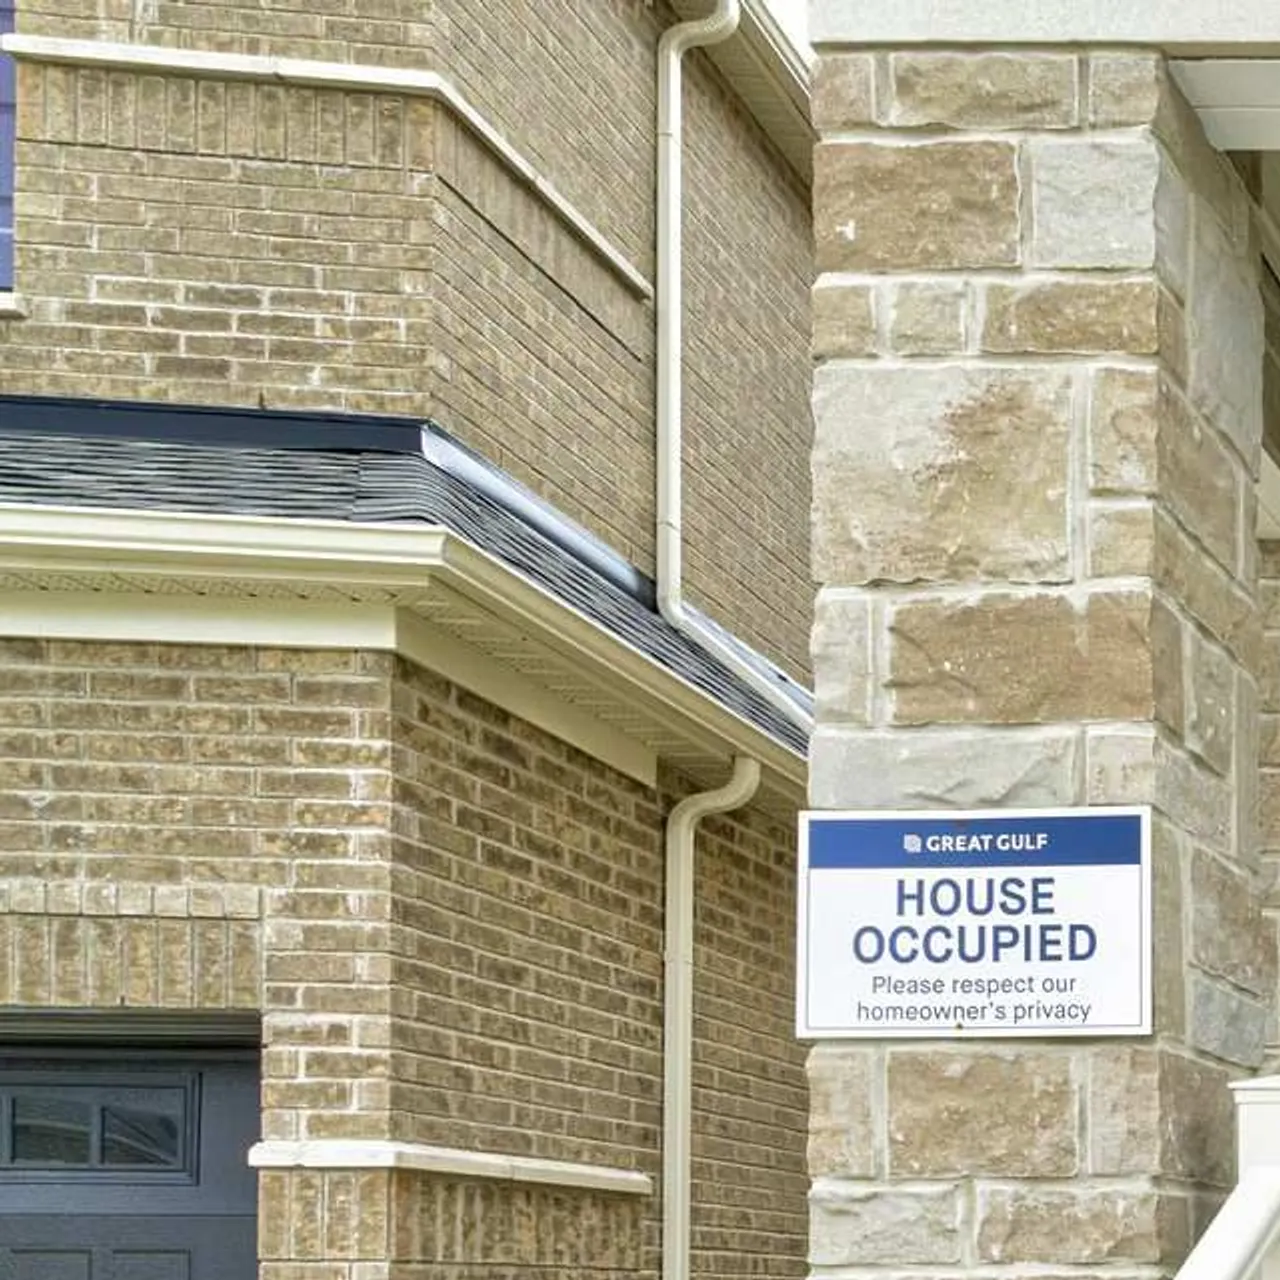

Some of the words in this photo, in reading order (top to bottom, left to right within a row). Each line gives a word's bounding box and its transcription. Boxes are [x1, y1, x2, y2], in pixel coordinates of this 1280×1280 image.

[926, 834, 994, 852] GREAT
[996, 833, 1048, 851] GULF
[896, 876, 1056, 917] HOUSE
[852, 923, 1098, 964] OCCUPIED
[871, 975, 946, 995] Please
[951, 975, 1034, 1003] respect
[1041, 977, 1077, 994] our
[856, 1000, 1007, 1022] homeowner's
[1013, 1000, 1092, 1024] privacy
